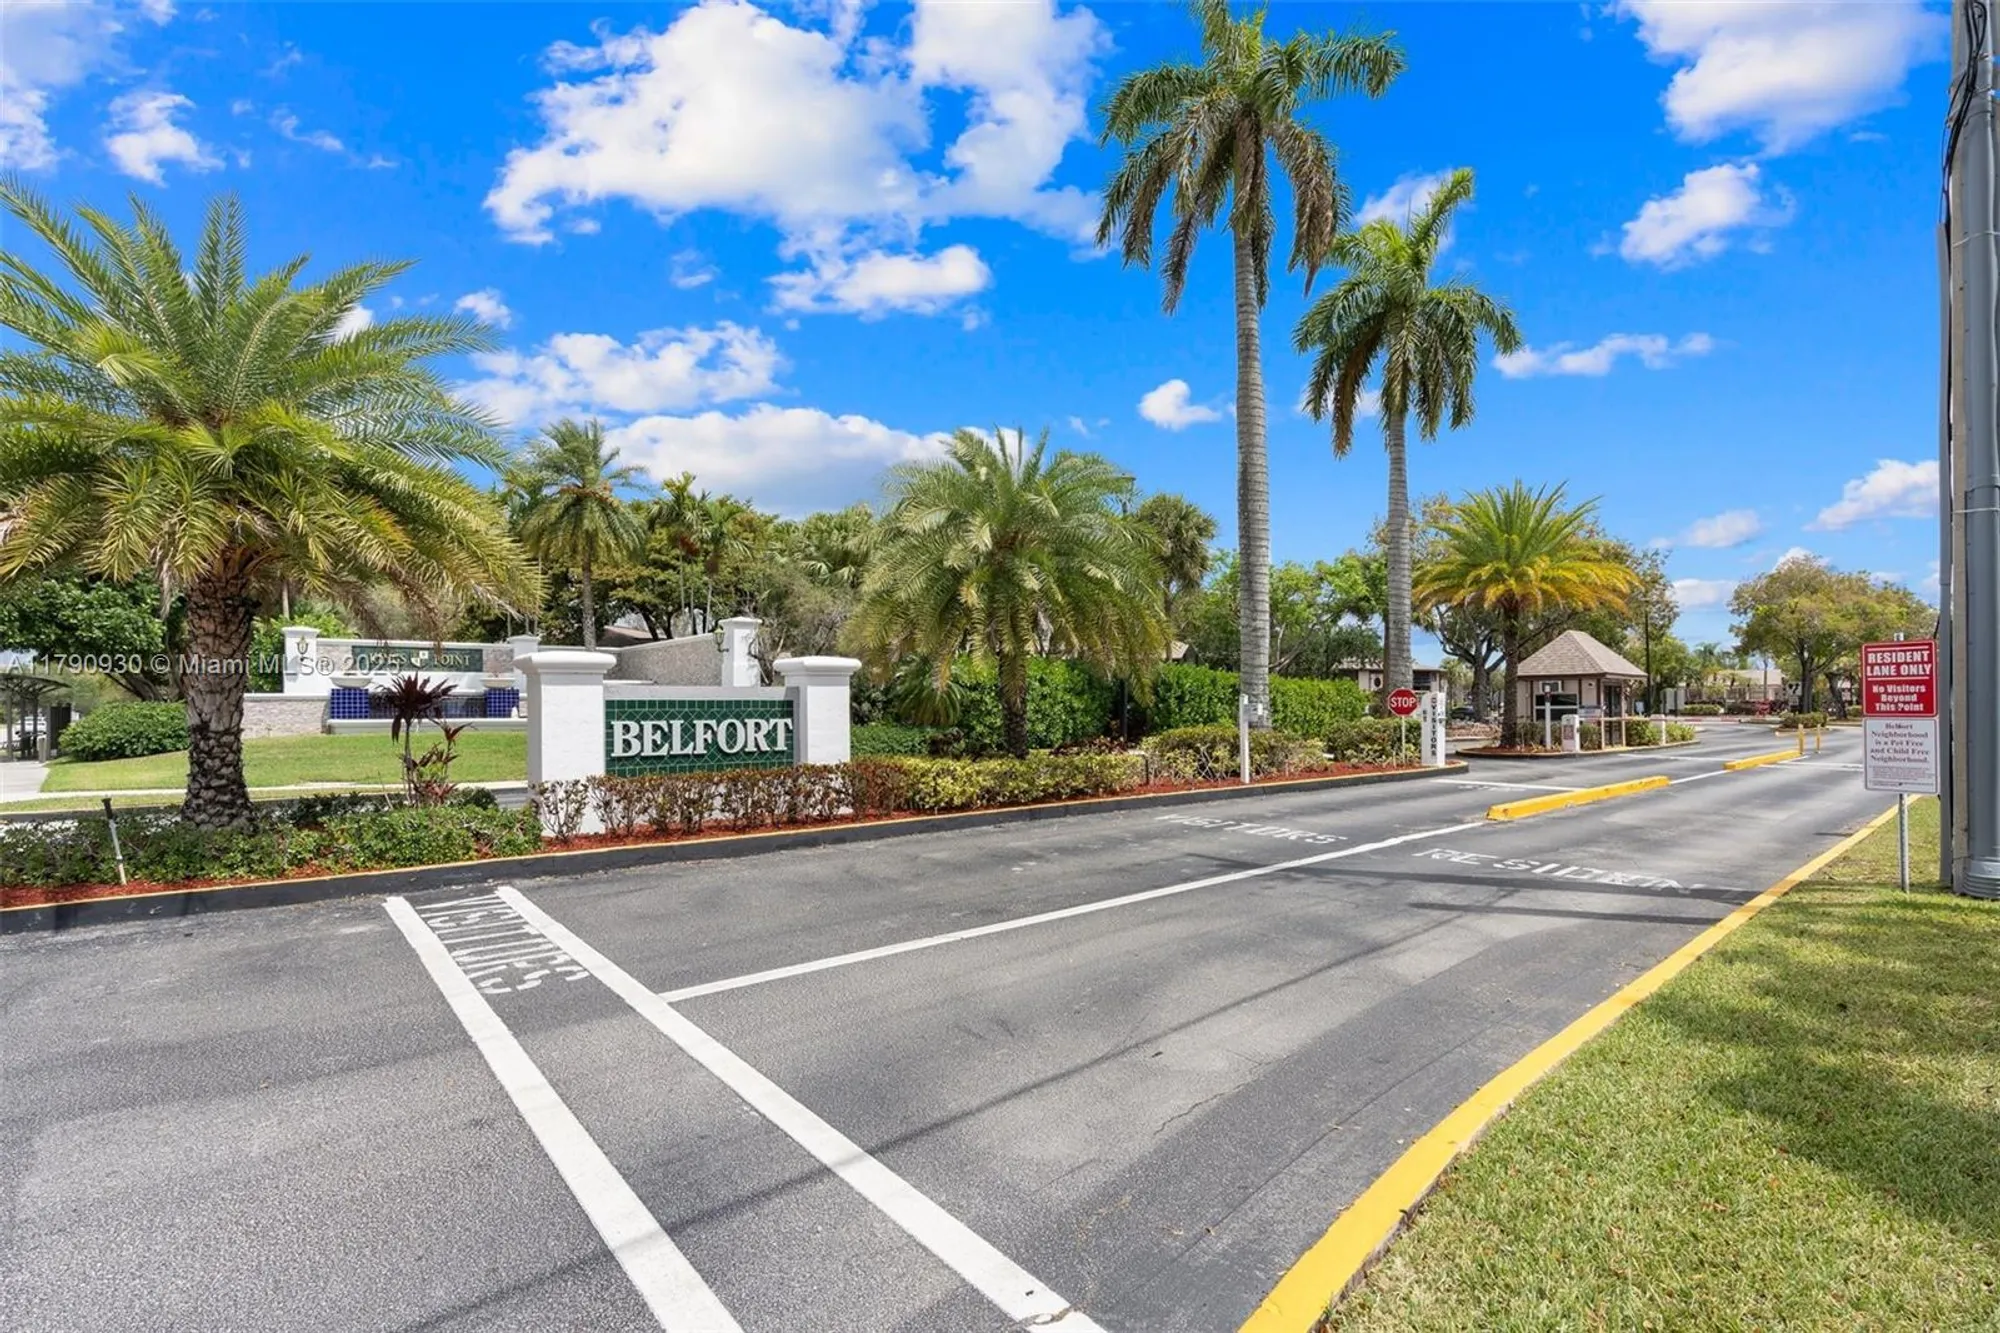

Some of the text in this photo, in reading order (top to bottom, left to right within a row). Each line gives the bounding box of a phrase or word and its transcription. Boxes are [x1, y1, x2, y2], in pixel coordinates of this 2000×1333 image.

[1867, 651, 1930, 664] RESIDENT
[1866, 664, 1932, 676] LANE ONLY
[1872, 684, 1926, 693] No Visitors
[1390, 697, 1416, 708] STOP
[1881, 694, 1918, 703] Beyond
[1875, 703, 1924, 711] This Point
[611, 718, 793, 757] BELFORT
[413, 893, 590, 995] VISITORS
